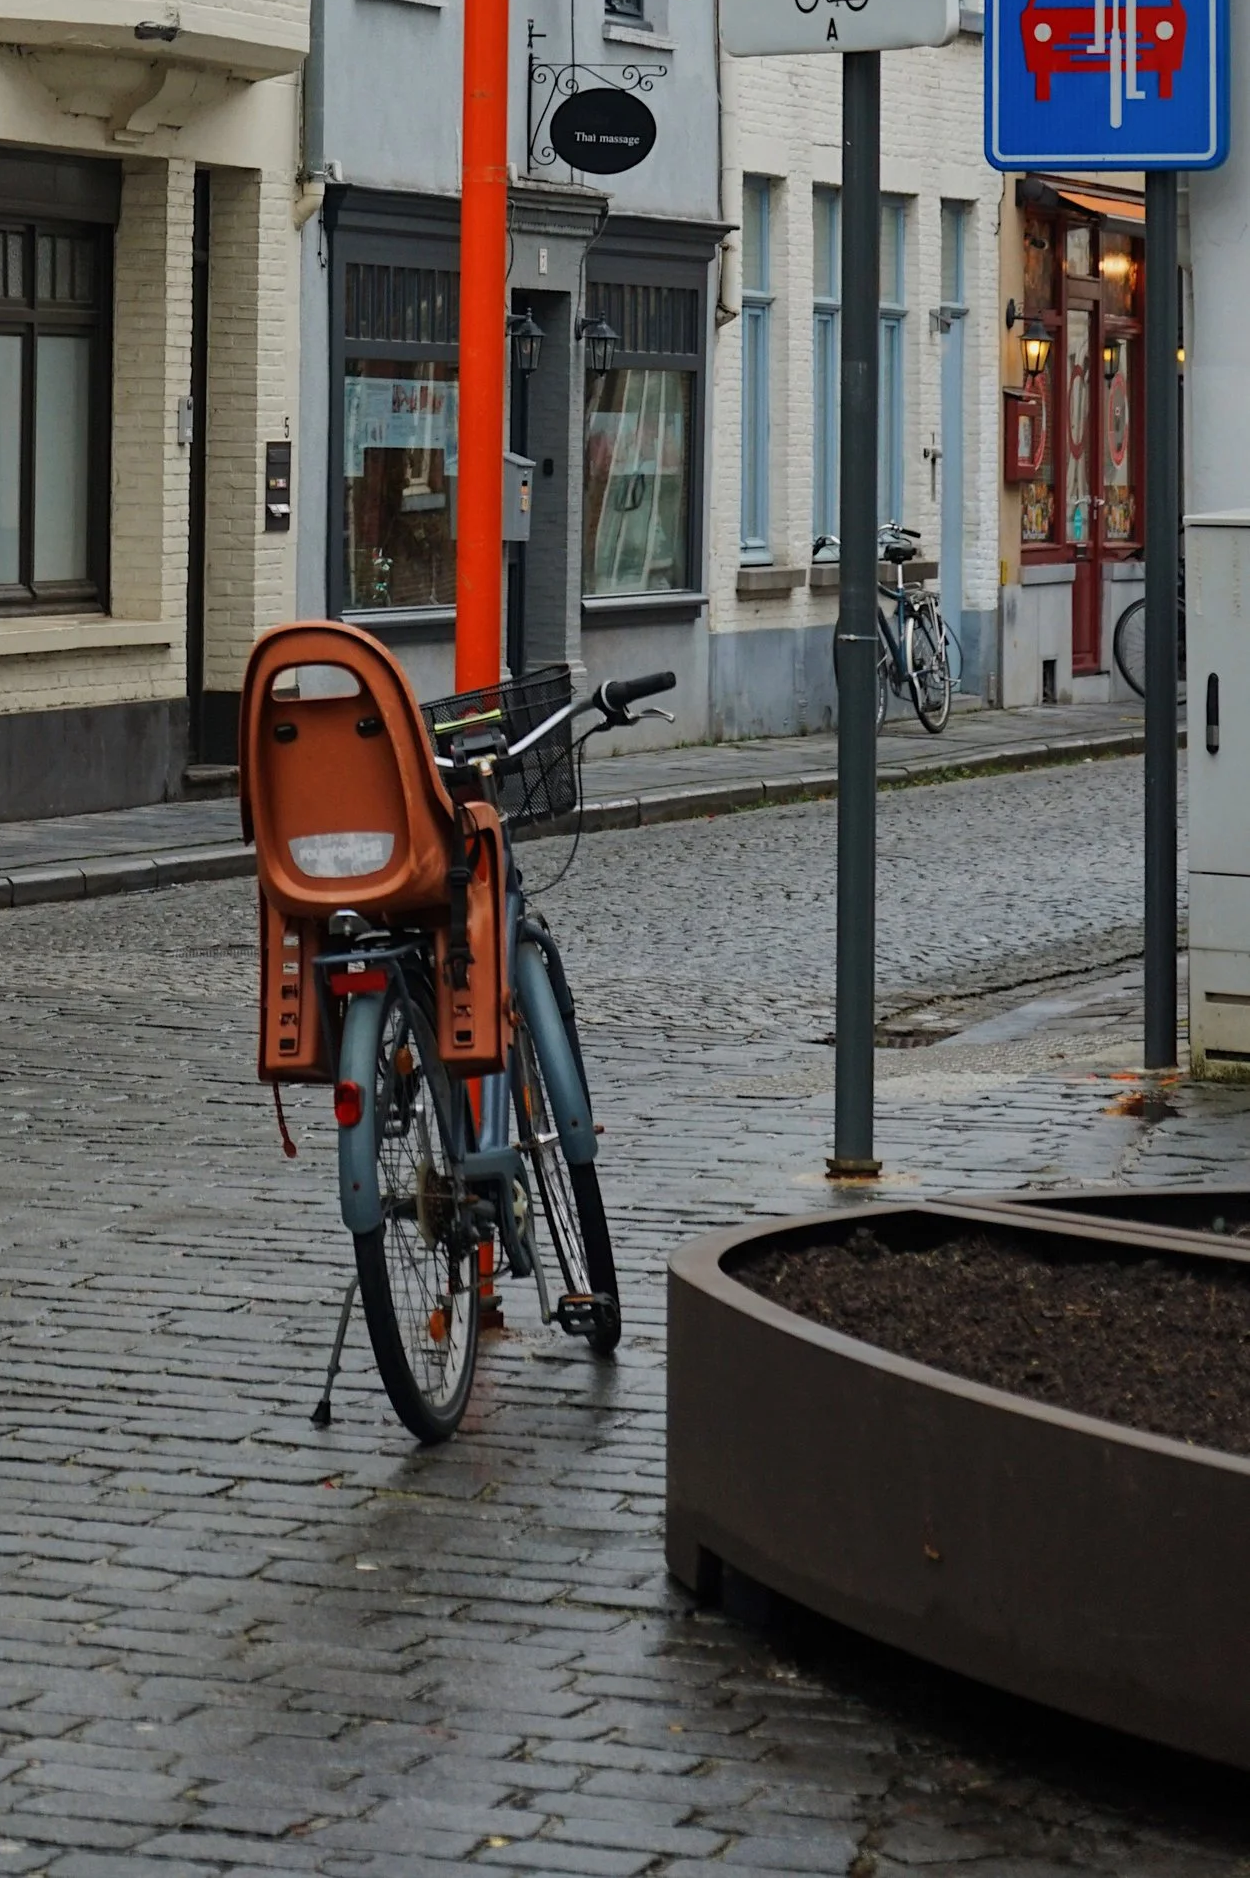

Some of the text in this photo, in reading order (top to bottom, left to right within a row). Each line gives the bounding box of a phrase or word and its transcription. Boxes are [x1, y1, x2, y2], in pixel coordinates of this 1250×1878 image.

[826, 17, 838, 41] A
[574, 131, 640, 147] Thai massage
[284, 416, 290, 439] 5
